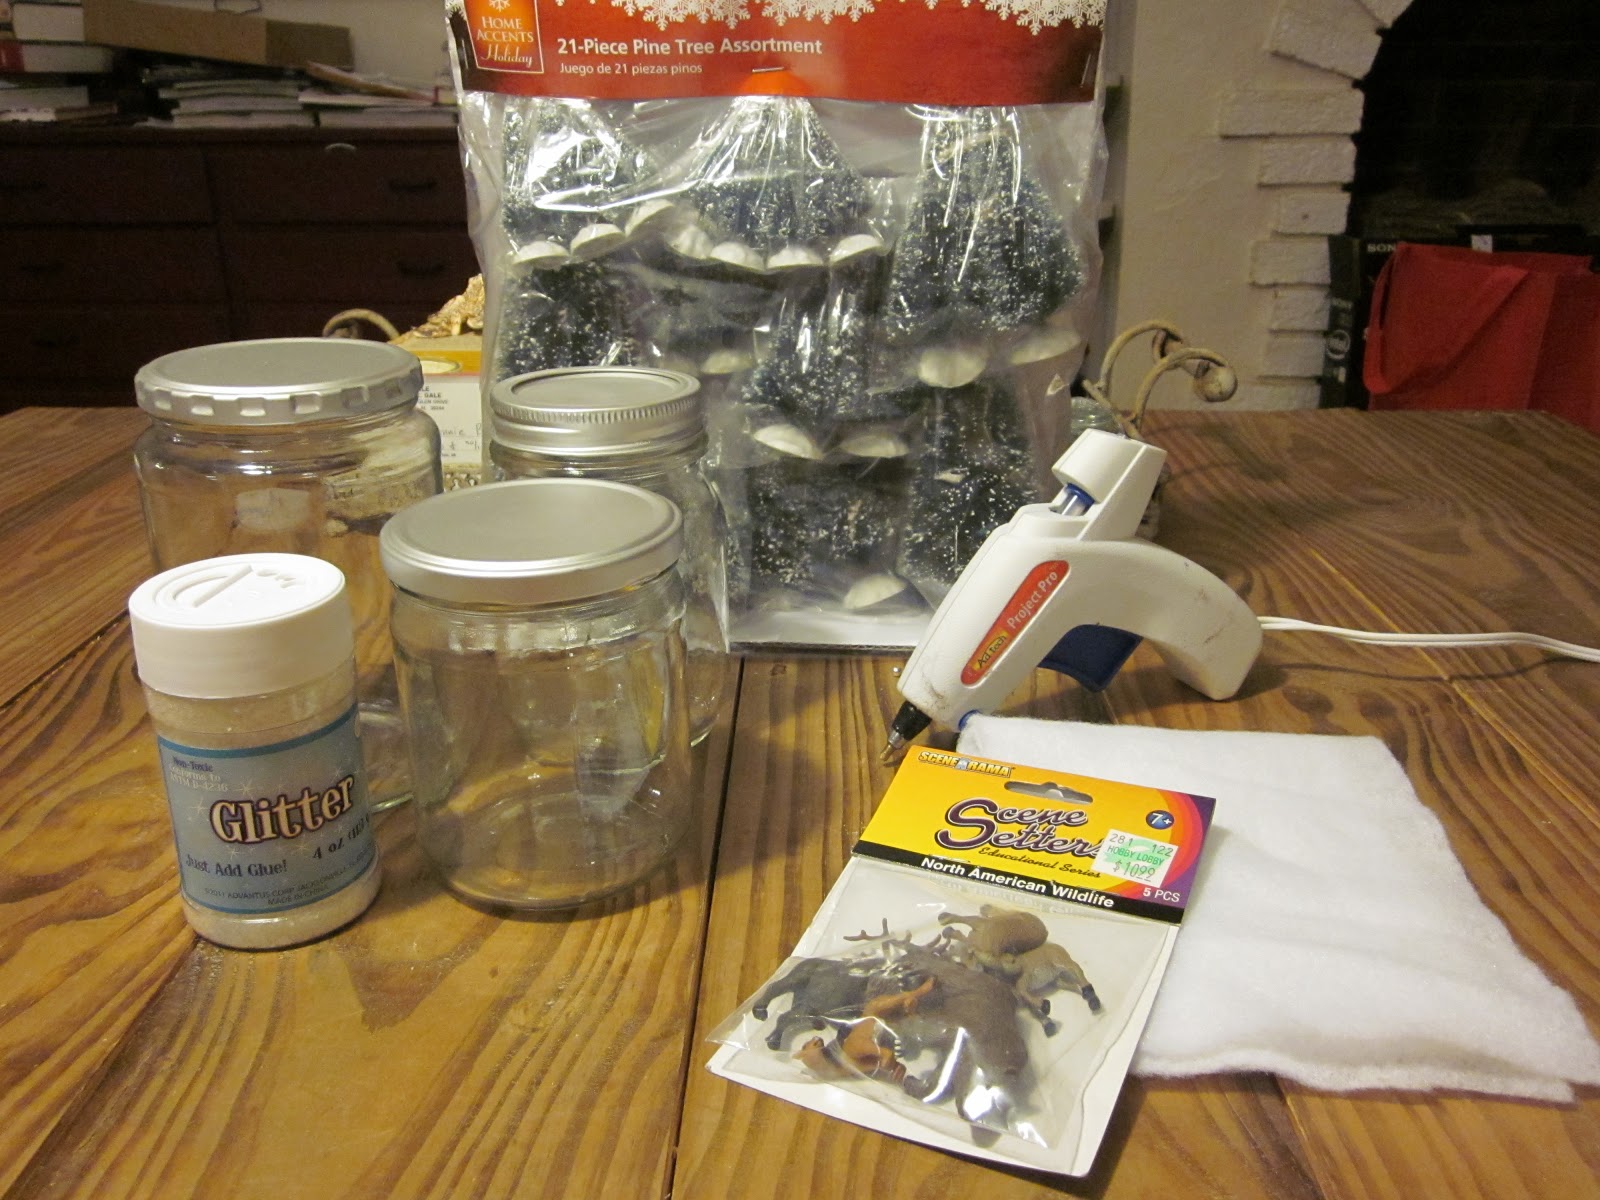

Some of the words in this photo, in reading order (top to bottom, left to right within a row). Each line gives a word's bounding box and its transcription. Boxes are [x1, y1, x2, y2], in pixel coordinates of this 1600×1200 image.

[481, 16, 523, 30] HOME
[476, 29, 534, 43] ACCENTS
[557, 38, 628, 55] 21-Piece
[633, 38, 671, 55] Pine
[674, 38, 715, 55] Tree
[720, 37, 823, 54] Assortment
[480, 44, 533, 68] Holiday
[560, 62, 594, 75] Juego
[596, 62, 611, 74] de
[614, 63, 628, 74] 21
[631, 62, 669, 76] piezas
[671, 62, 703, 76] pinos
[1367, 243, 1396, 253] SON
[1007, 591, 1042, 630] Project
[1037, 572, 1058, 593] Pro
[210, 774, 354, 844] Glitter
[1150, 812, 1173, 825] 7+
[313, 846, 322, 859] 4
[1108, 833, 1133, 847] 281
[1151, 844, 1174, 858] 122
[186, 853, 210, 875] Just
[215, 862, 243, 878] Add
[247, 859, 288, 878] Glue!
[978, 846, 1057, 870] Educational
[1058, 864, 1102, 879] Series
[1106, 845, 1137, 859] HOBBY
[1136, 853, 1165, 867] LOBBY
[921, 857, 966, 876] North
[968, 866, 1047, 894] American
[1051, 883, 1116, 909] Wildlife
[1142, 887, 1152, 897] 5
[1154, 889, 1181, 903] PCS
